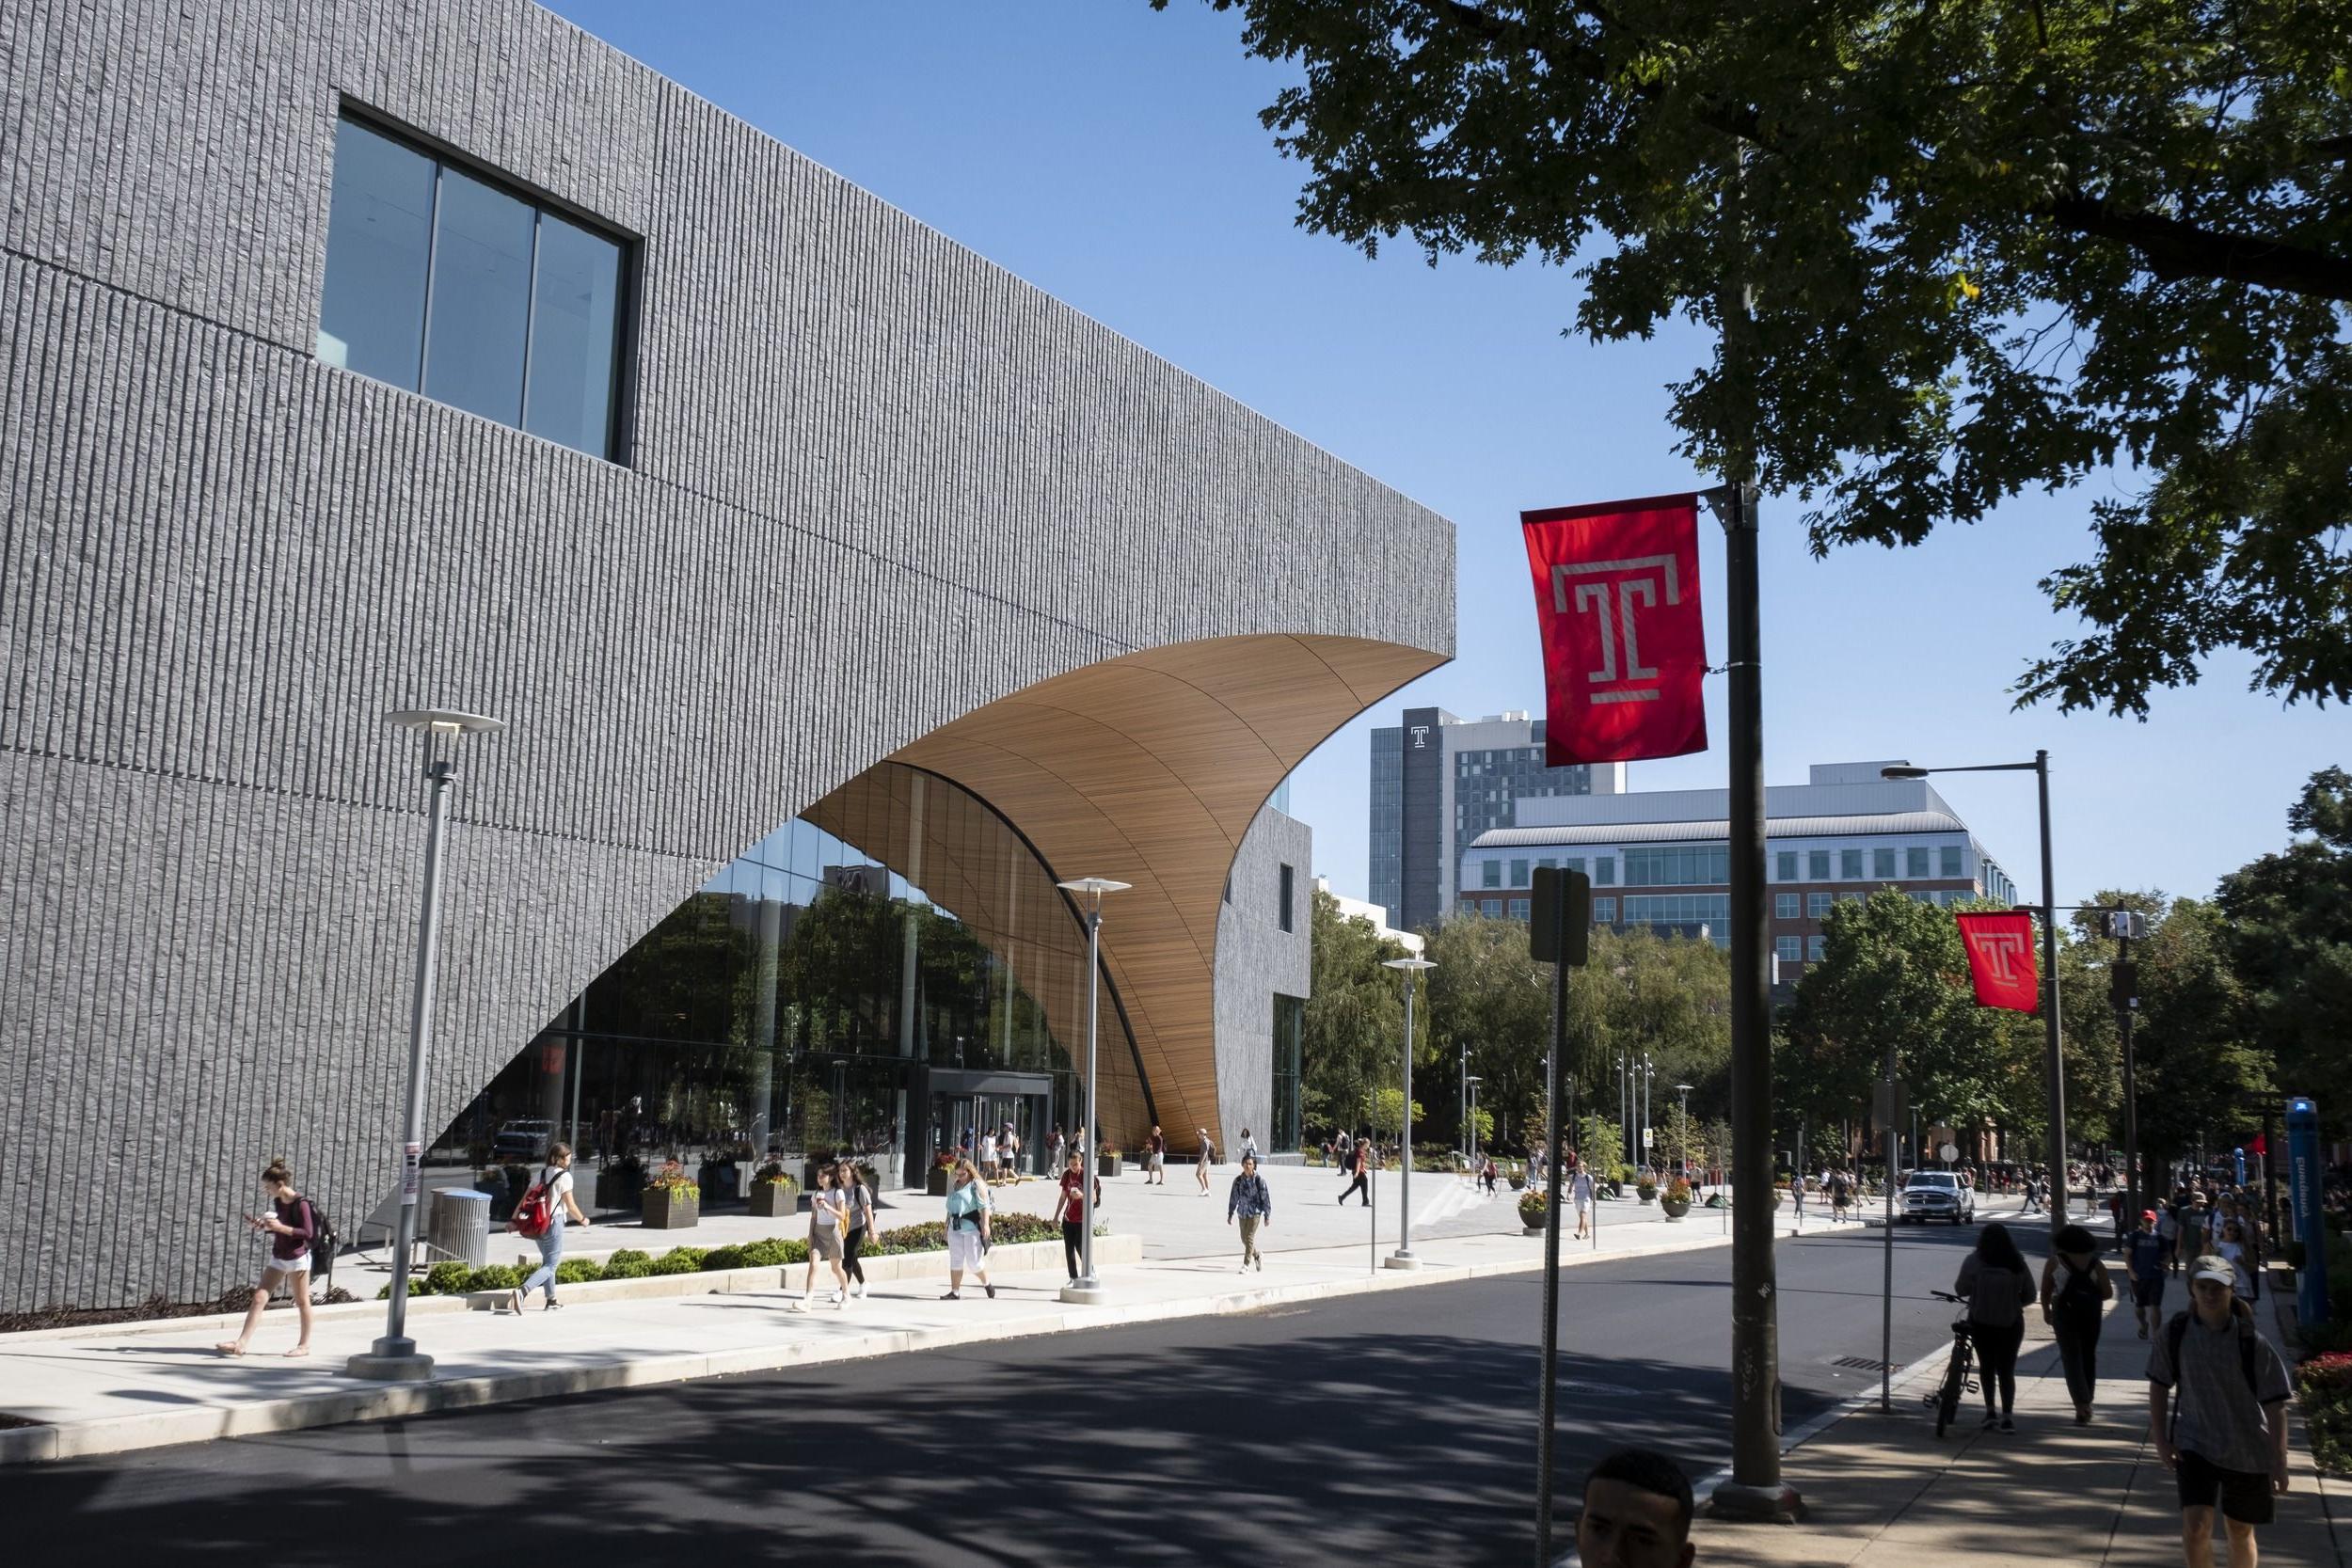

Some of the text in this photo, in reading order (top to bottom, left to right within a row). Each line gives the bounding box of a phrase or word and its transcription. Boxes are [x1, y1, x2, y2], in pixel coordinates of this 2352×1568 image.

[1550, 553, 1680, 705] T
[1410, 725, 1429, 749] T
[1971, 932, 2025, 988] T
